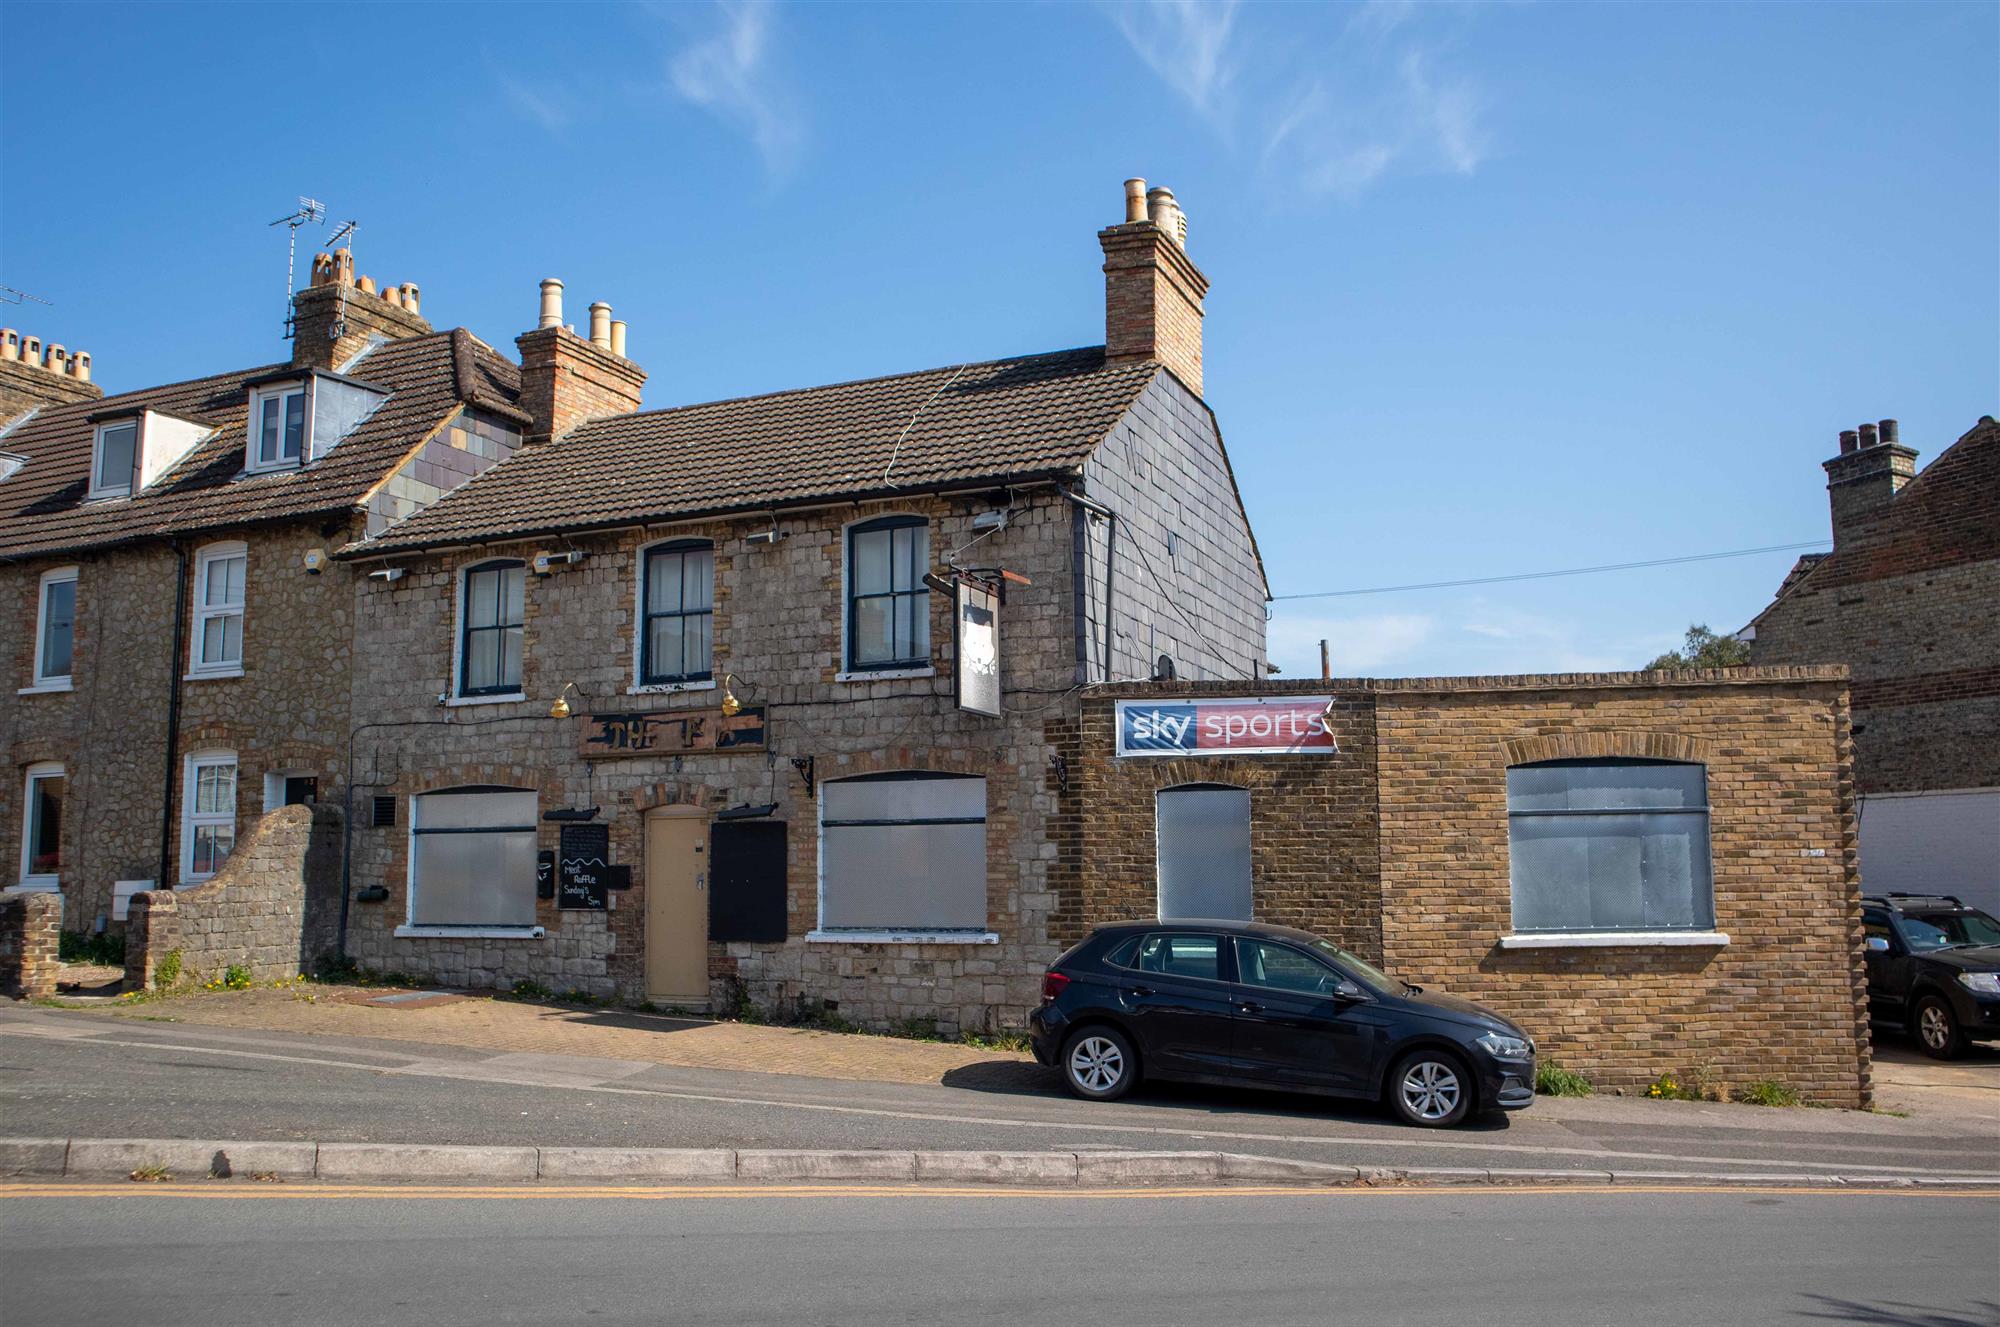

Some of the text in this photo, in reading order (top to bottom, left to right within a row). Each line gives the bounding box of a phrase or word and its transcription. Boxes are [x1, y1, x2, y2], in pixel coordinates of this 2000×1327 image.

[1133, 709, 1327, 745] sky sports
[564, 864, 582, 874] Meat
[573, 874, 596, 884] Raffle
[563, 884, 590, 899] Sunday's
[587, 896, 601, 907] 5pm
